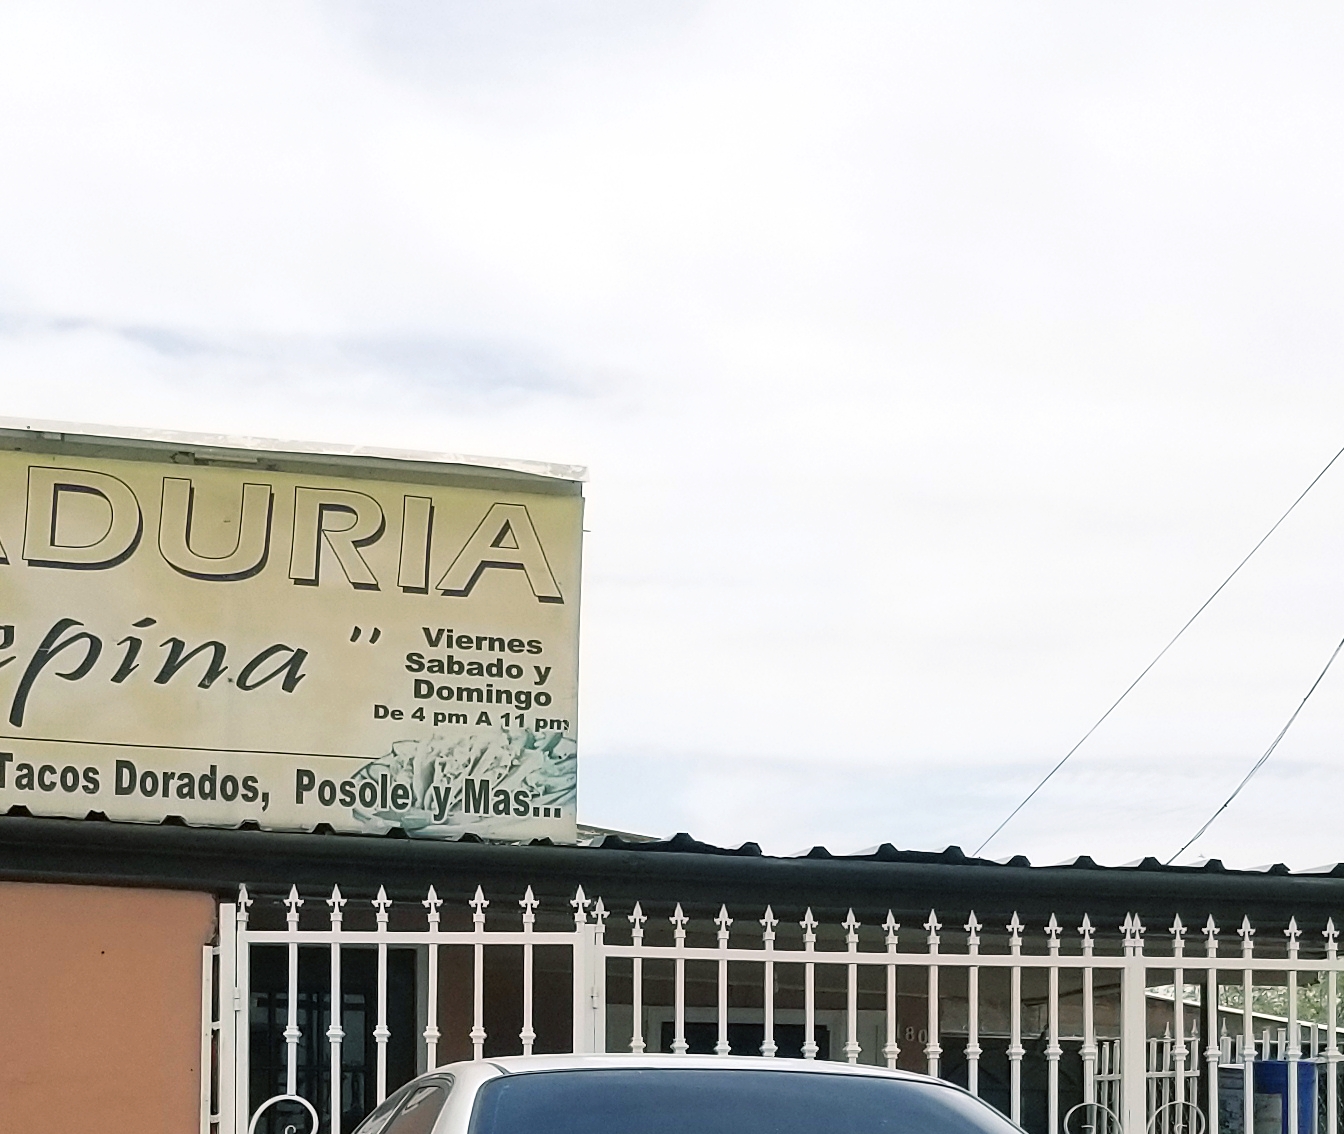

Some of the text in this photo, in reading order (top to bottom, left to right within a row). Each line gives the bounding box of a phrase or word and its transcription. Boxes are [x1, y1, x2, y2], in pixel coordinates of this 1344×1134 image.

[421, 626, 544, 655] Viernes
[404, 652, 552, 686] Sabado y
[413, 678, 553, 711] Domingo
[373, 703, 570, 733] De 4 pm A 11 pm
[114, 758, 270, 812] Dorados,
[295, 768, 411, 812] Posole
[432, 784, 453, 822] y
[463, 777, 563, 819] Mas...
